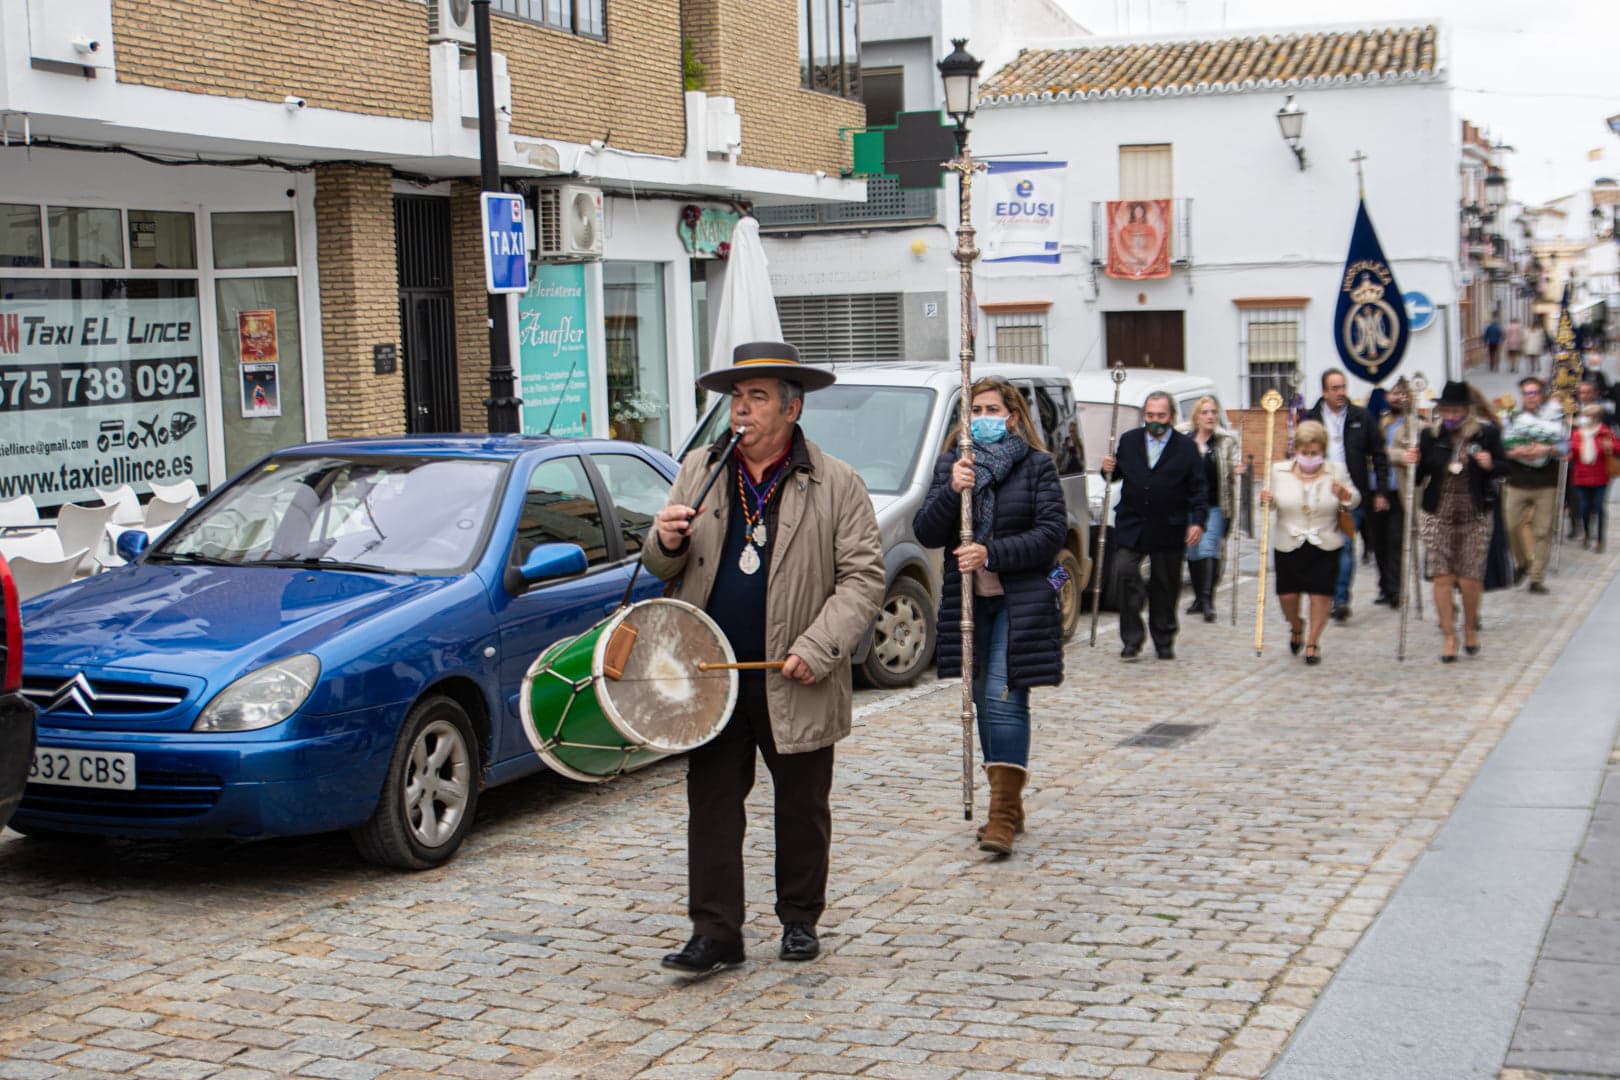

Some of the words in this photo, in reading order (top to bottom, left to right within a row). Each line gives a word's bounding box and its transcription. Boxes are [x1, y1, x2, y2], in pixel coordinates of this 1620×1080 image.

[995, 202, 1054, 217] EDUSI
[490, 231, 525, 256] TAXI
[23, 316, 74, 346] Taxi
[80, 317, 118, 346] EL
[127, 316, 191, 344] Lince
[519, 308, 584, 357] Anaflor
[60, 367, 126, 402] 738
[136, 362, 195, 397] 092
[0, 439, 89, 457] iellince@gmail.com
[79, 756, 126, 784] CBS
